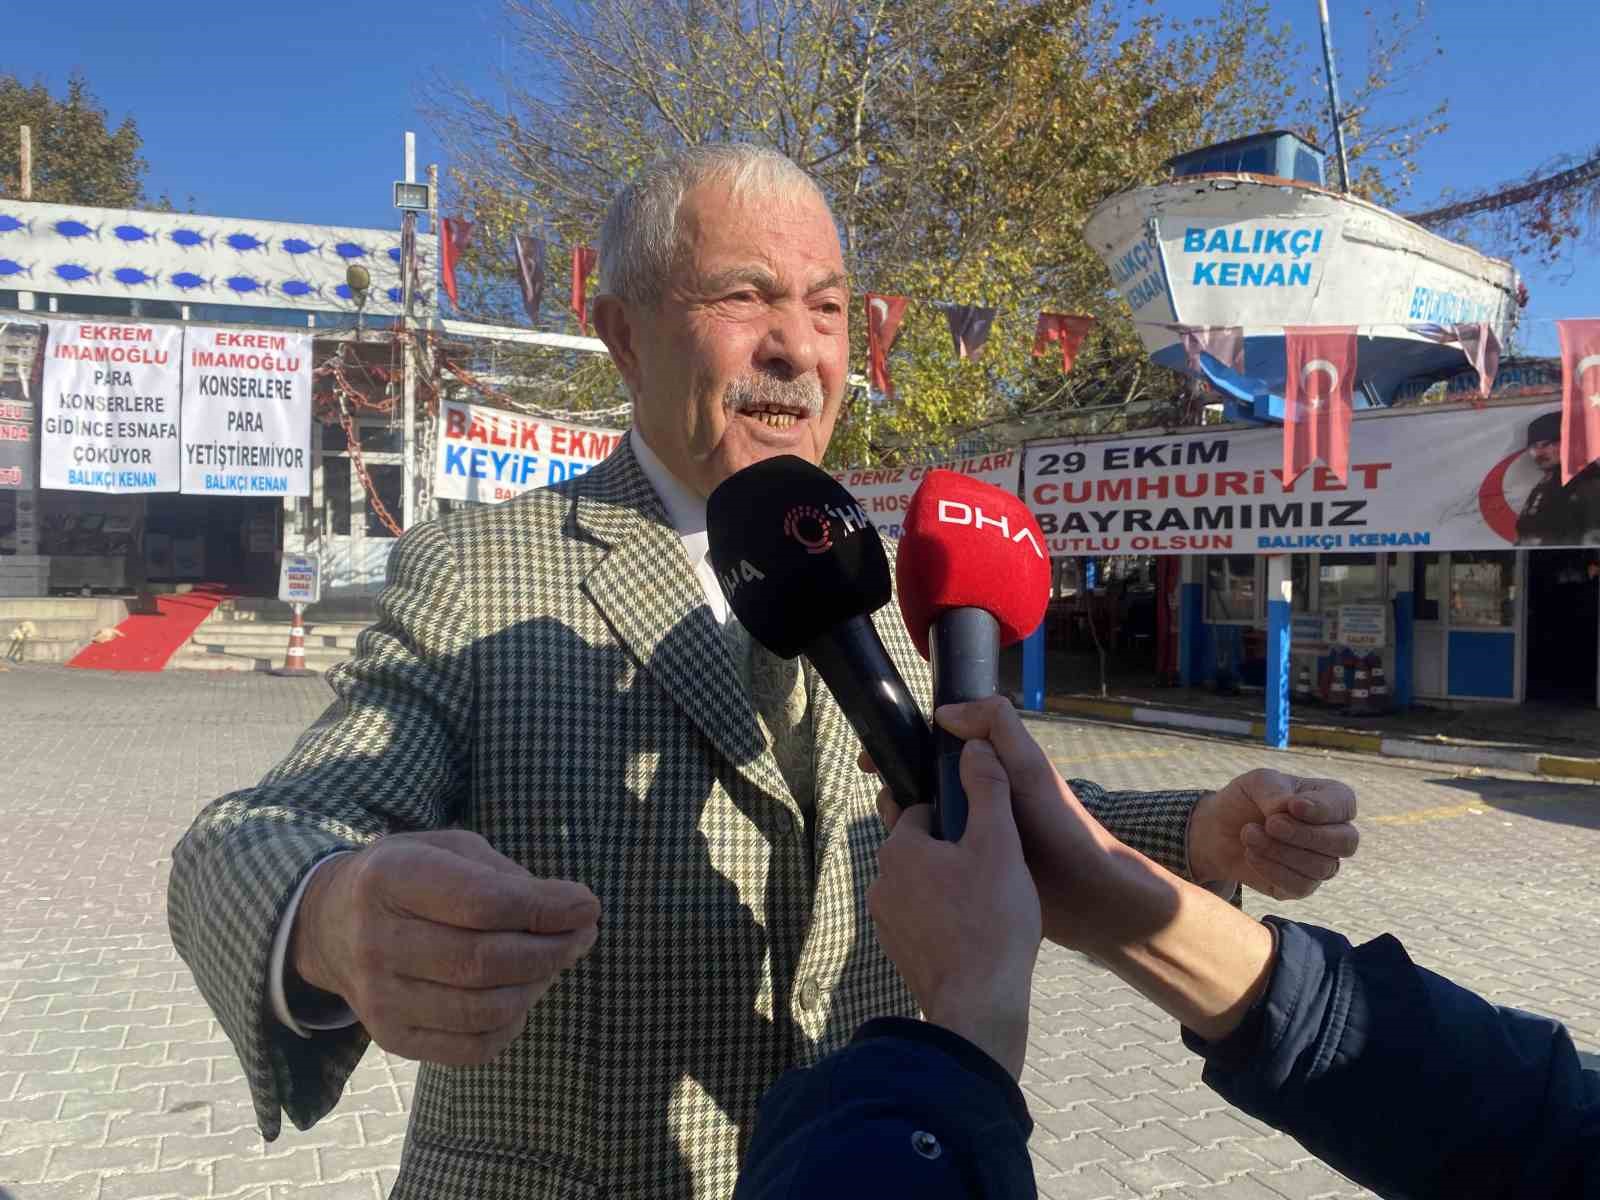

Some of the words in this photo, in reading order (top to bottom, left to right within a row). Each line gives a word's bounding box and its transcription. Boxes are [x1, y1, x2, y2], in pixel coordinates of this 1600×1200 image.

[1183, 227, 1323, 259] BALIKÇI
[1192, 262, 1312, 286] KENAN
[79, 324, 153, 342] EKREM
[215, 332, 286, 351] EKREM
[192, 348, 300, 372] İMAMOĞLU
[94, 370, 133, 387] PARA
[199, 375, 292, 400] KONSERLERE
[59, 393, 165, 413] KONSERLERE
[45, 415, 114, 438] GİDİNCE
[118, 422, 177, 439] ESNAFA
[227, 410, 264, 433] PARA
[73, 442, 152, 465] ÇÖKÜYOR
[185, 440, 304, 471] YETİŞTİREMİYOR
[1036, 451, 1086, 475] 29
[68, 469, 116, 489] BALIKÇI
[118, 470, 157, 488] KENAN
[205, 473, 248, 493] BALIKÇI
[250, 475, 288, 491] KENAN
[548, 460, 593, 485] DE
[1036, 500, 1368, 534] BAYRAMIMIZ
[1130, 534, 1233, 550] OLSUN
[1257, 534, 1343, 550] BALIKÇI
[1349, 531, 1431, 547] KENAN
